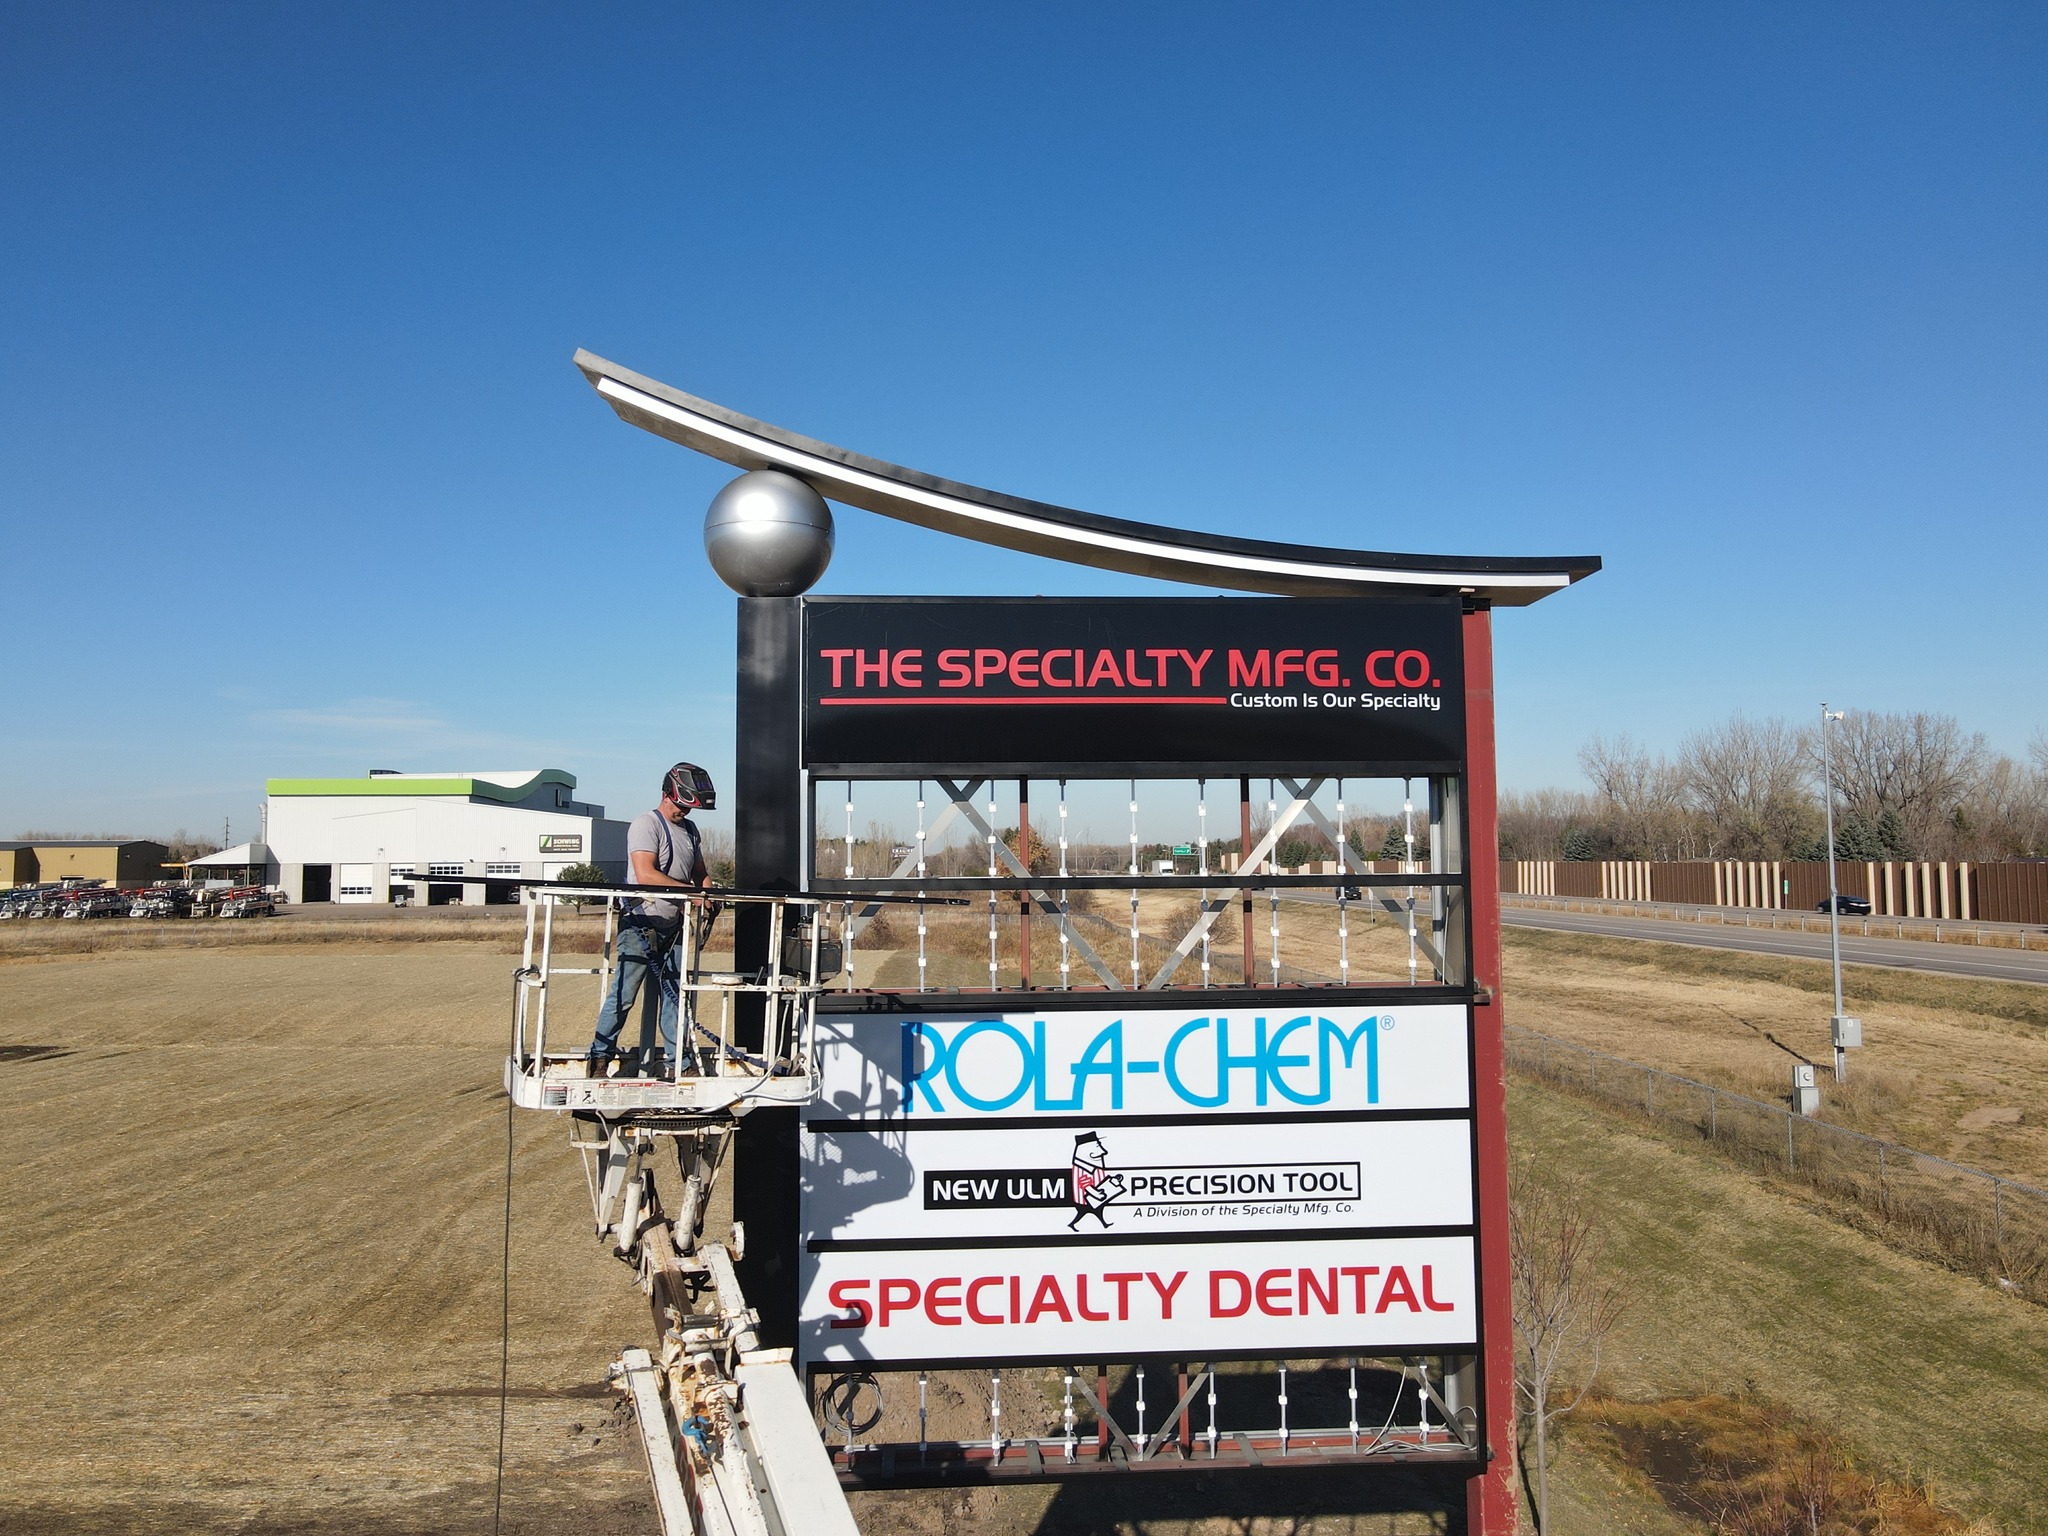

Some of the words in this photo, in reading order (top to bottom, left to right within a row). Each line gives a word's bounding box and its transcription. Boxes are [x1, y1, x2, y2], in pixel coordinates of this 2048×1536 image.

[821, 649, 923, 688] THE
[937, 648, 1213, 688] SPECIALTY
[1227, 648, 1351, 688] MFG.
[1364, 649, 1441, 688] CO.
[1230, 692, 1298, 708] Custom
[1303, 692, 1319, 708] Is
[1322, 692, 1357, 708] Our
[1360, 692, 1441, 711] Specialty
[932, 1179, 1000, 1201] NEW
[1007, 1178, 1065, 1200] ULM
[1131, 1173, 1275, 1197] PRECISION
[1283, 1171, 1353, 1193] TOOL
[1133, 1207, 1143, 1218] A
[1147, 1206, 1198, 1217] Division
[1202, 1205, 1215, 1216] of
[1219, 1204, 1238, 1216] the
[1242, 1203, 1300, 1217] Specialty
[1304, 1202, 1332, 1215] Mfg.
[1336, 1202, 1355, 1213] Co.
[827, 1271, 1188, 1328] SPECIALTY
[1209, 1265, 1455, 1318] DENTAL
